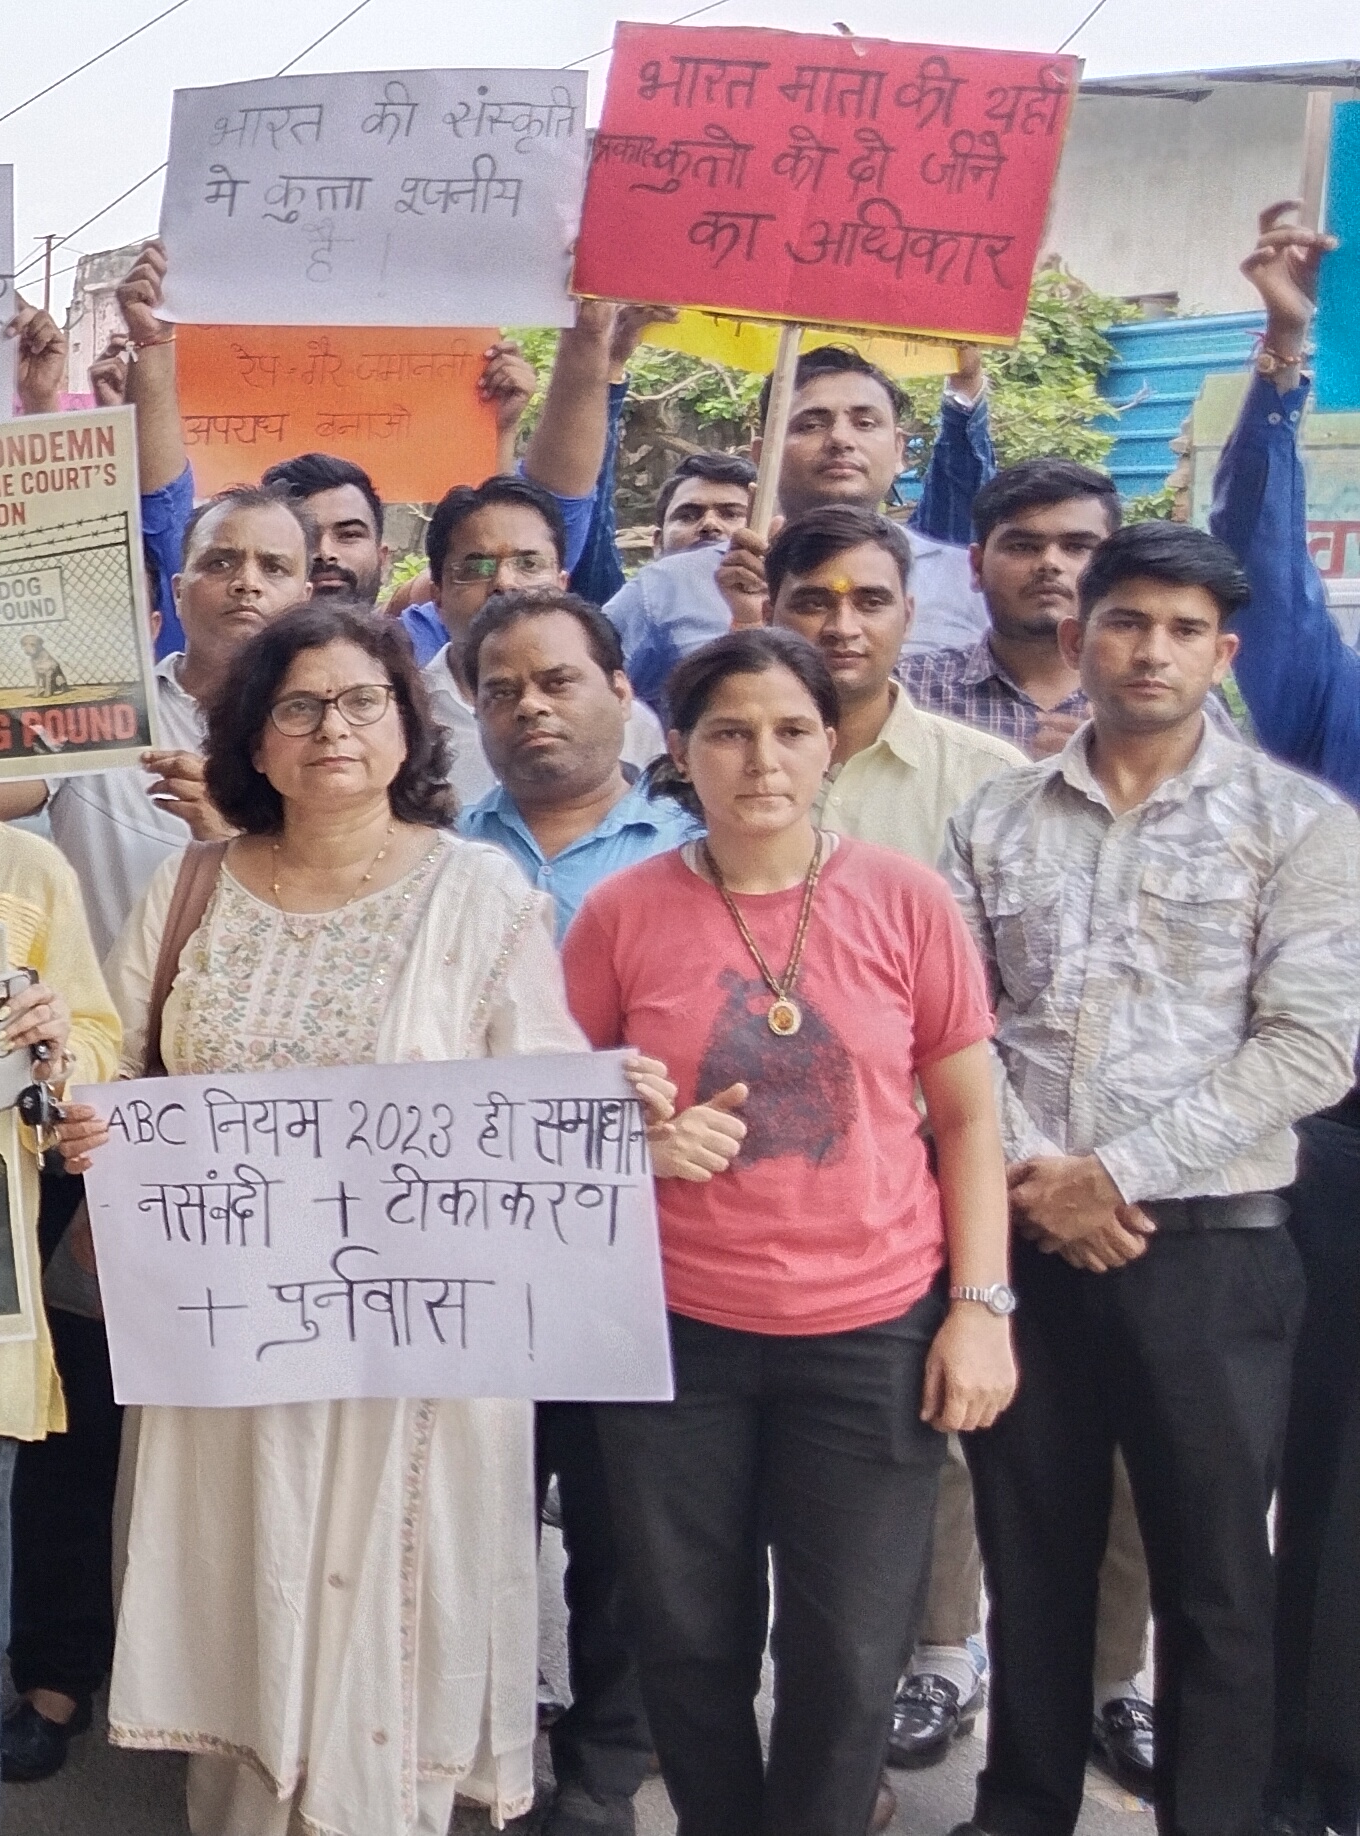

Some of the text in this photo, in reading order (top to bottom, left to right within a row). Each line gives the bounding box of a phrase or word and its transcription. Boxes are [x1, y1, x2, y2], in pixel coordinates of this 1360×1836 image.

[209, 104, 324, 149] भारत
[362, 81, 418, 144] की
[637, 56, 770, 109] भारत
[780, 65, 888, 120] माता
[893, 56, 971, 129] की
[688, 198, 1015, 289] का अधिकार
[21, 703, 138, 749] POUND
[105, 1099, 186, 1146] ABC
[204, 1087, 333, 1159] नियम
[346, 1099, 452, 1158] 2023
[474, 1091, 521, 1161] ही
